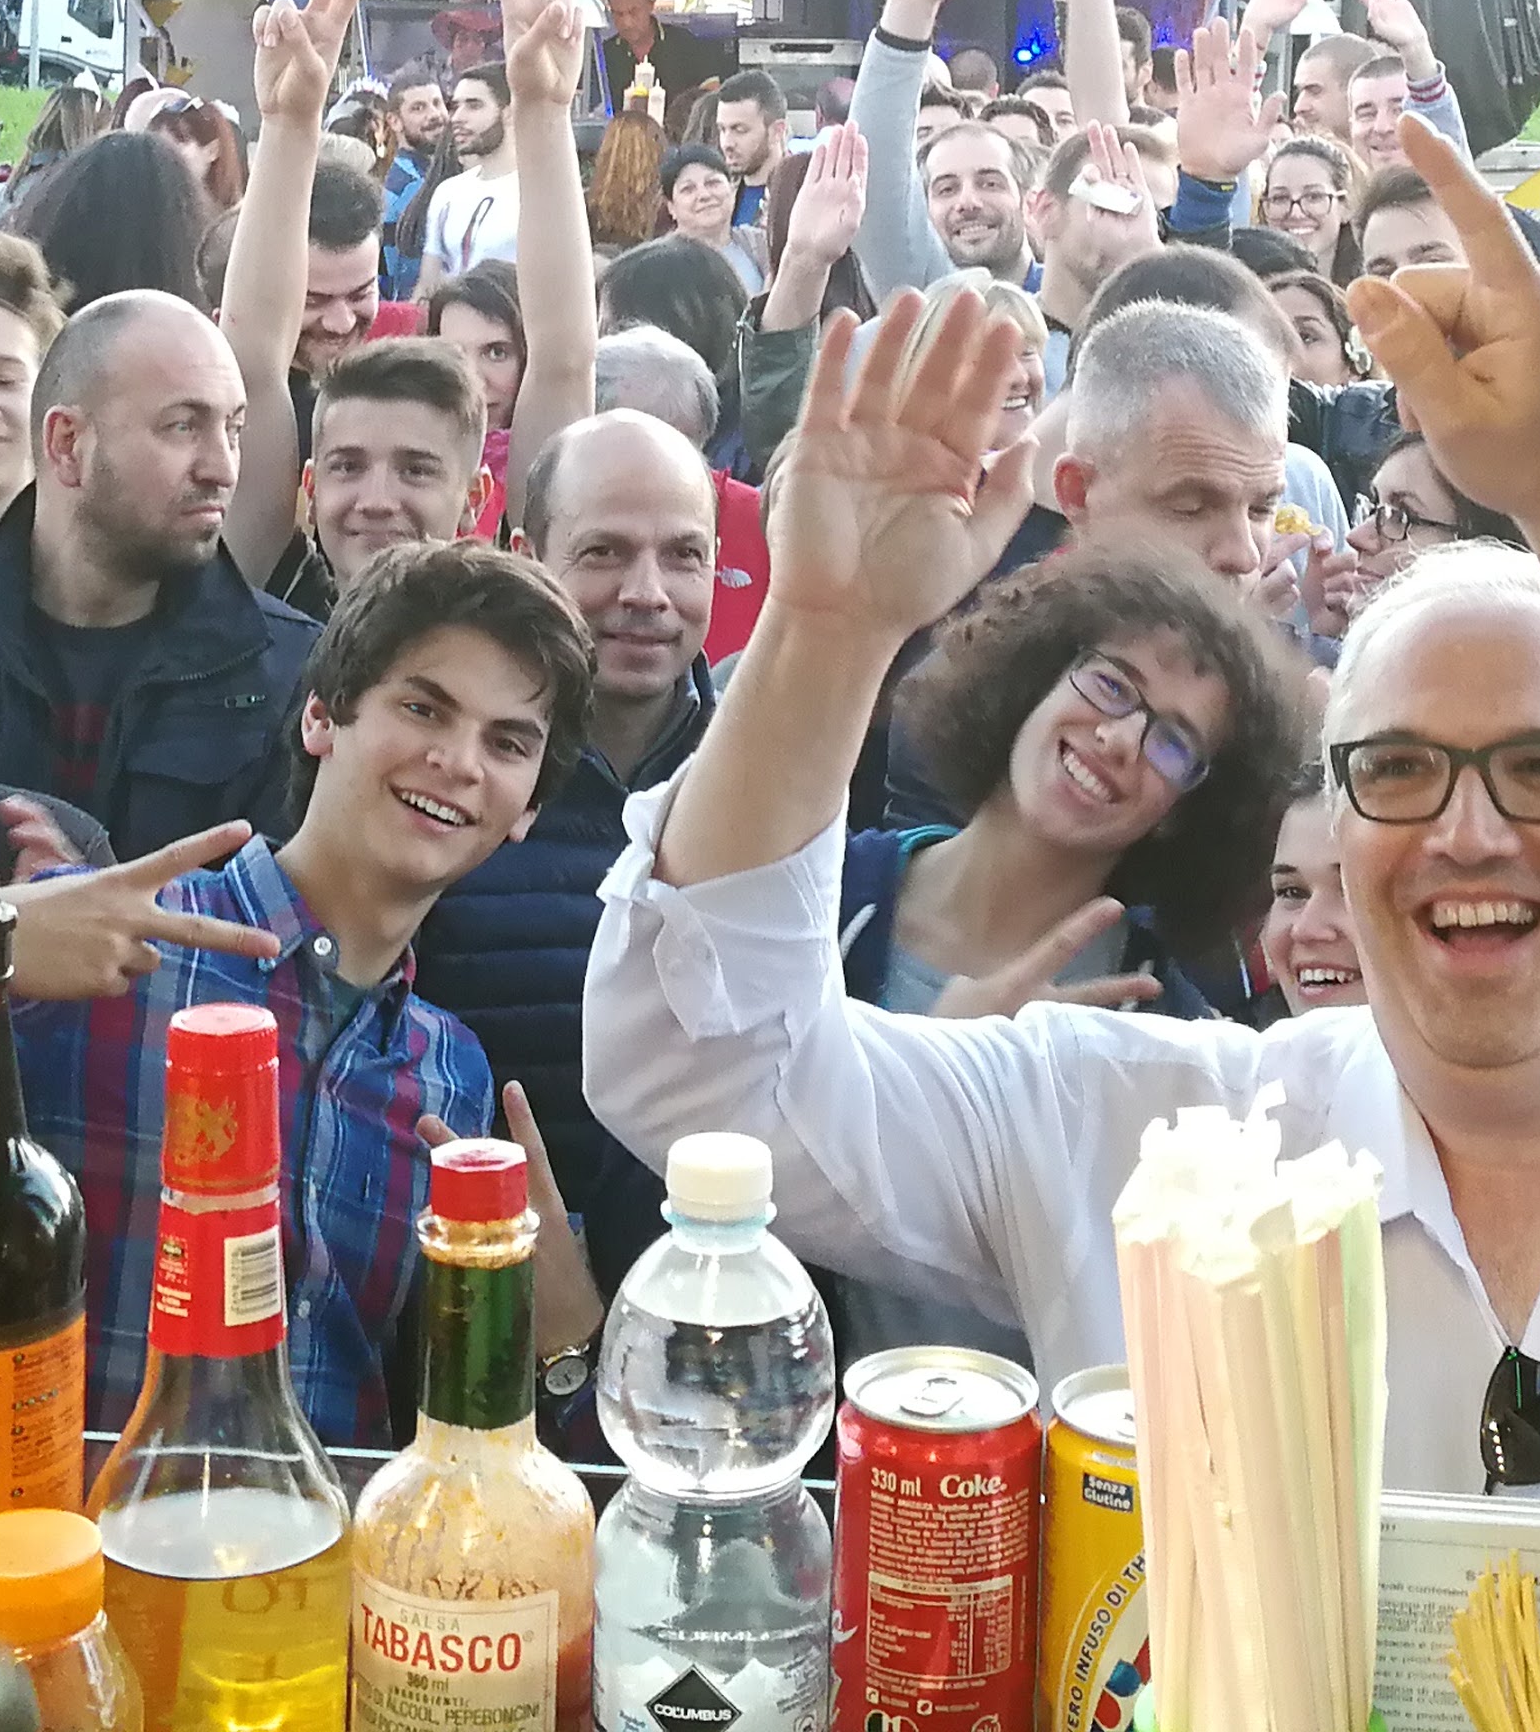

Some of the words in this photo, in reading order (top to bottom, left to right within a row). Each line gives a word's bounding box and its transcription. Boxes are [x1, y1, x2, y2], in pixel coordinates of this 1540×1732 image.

[871, 1467, 897, 1493] 330
[900, 1476, 923, 1497] ml
[1123, 1549, 1146, 1581] TH
[1106, 1583, 1128, 1608] DI
[400, 1608, 461, 1632] SALSA
[360, 1603, 522, 1673] TABASCO
[1075, 1609, 1112, 1681] INFUSO
[654, 1702, 732, 1722] COLUMBUS
[1067, 1685, 1084, 1732] ERO
